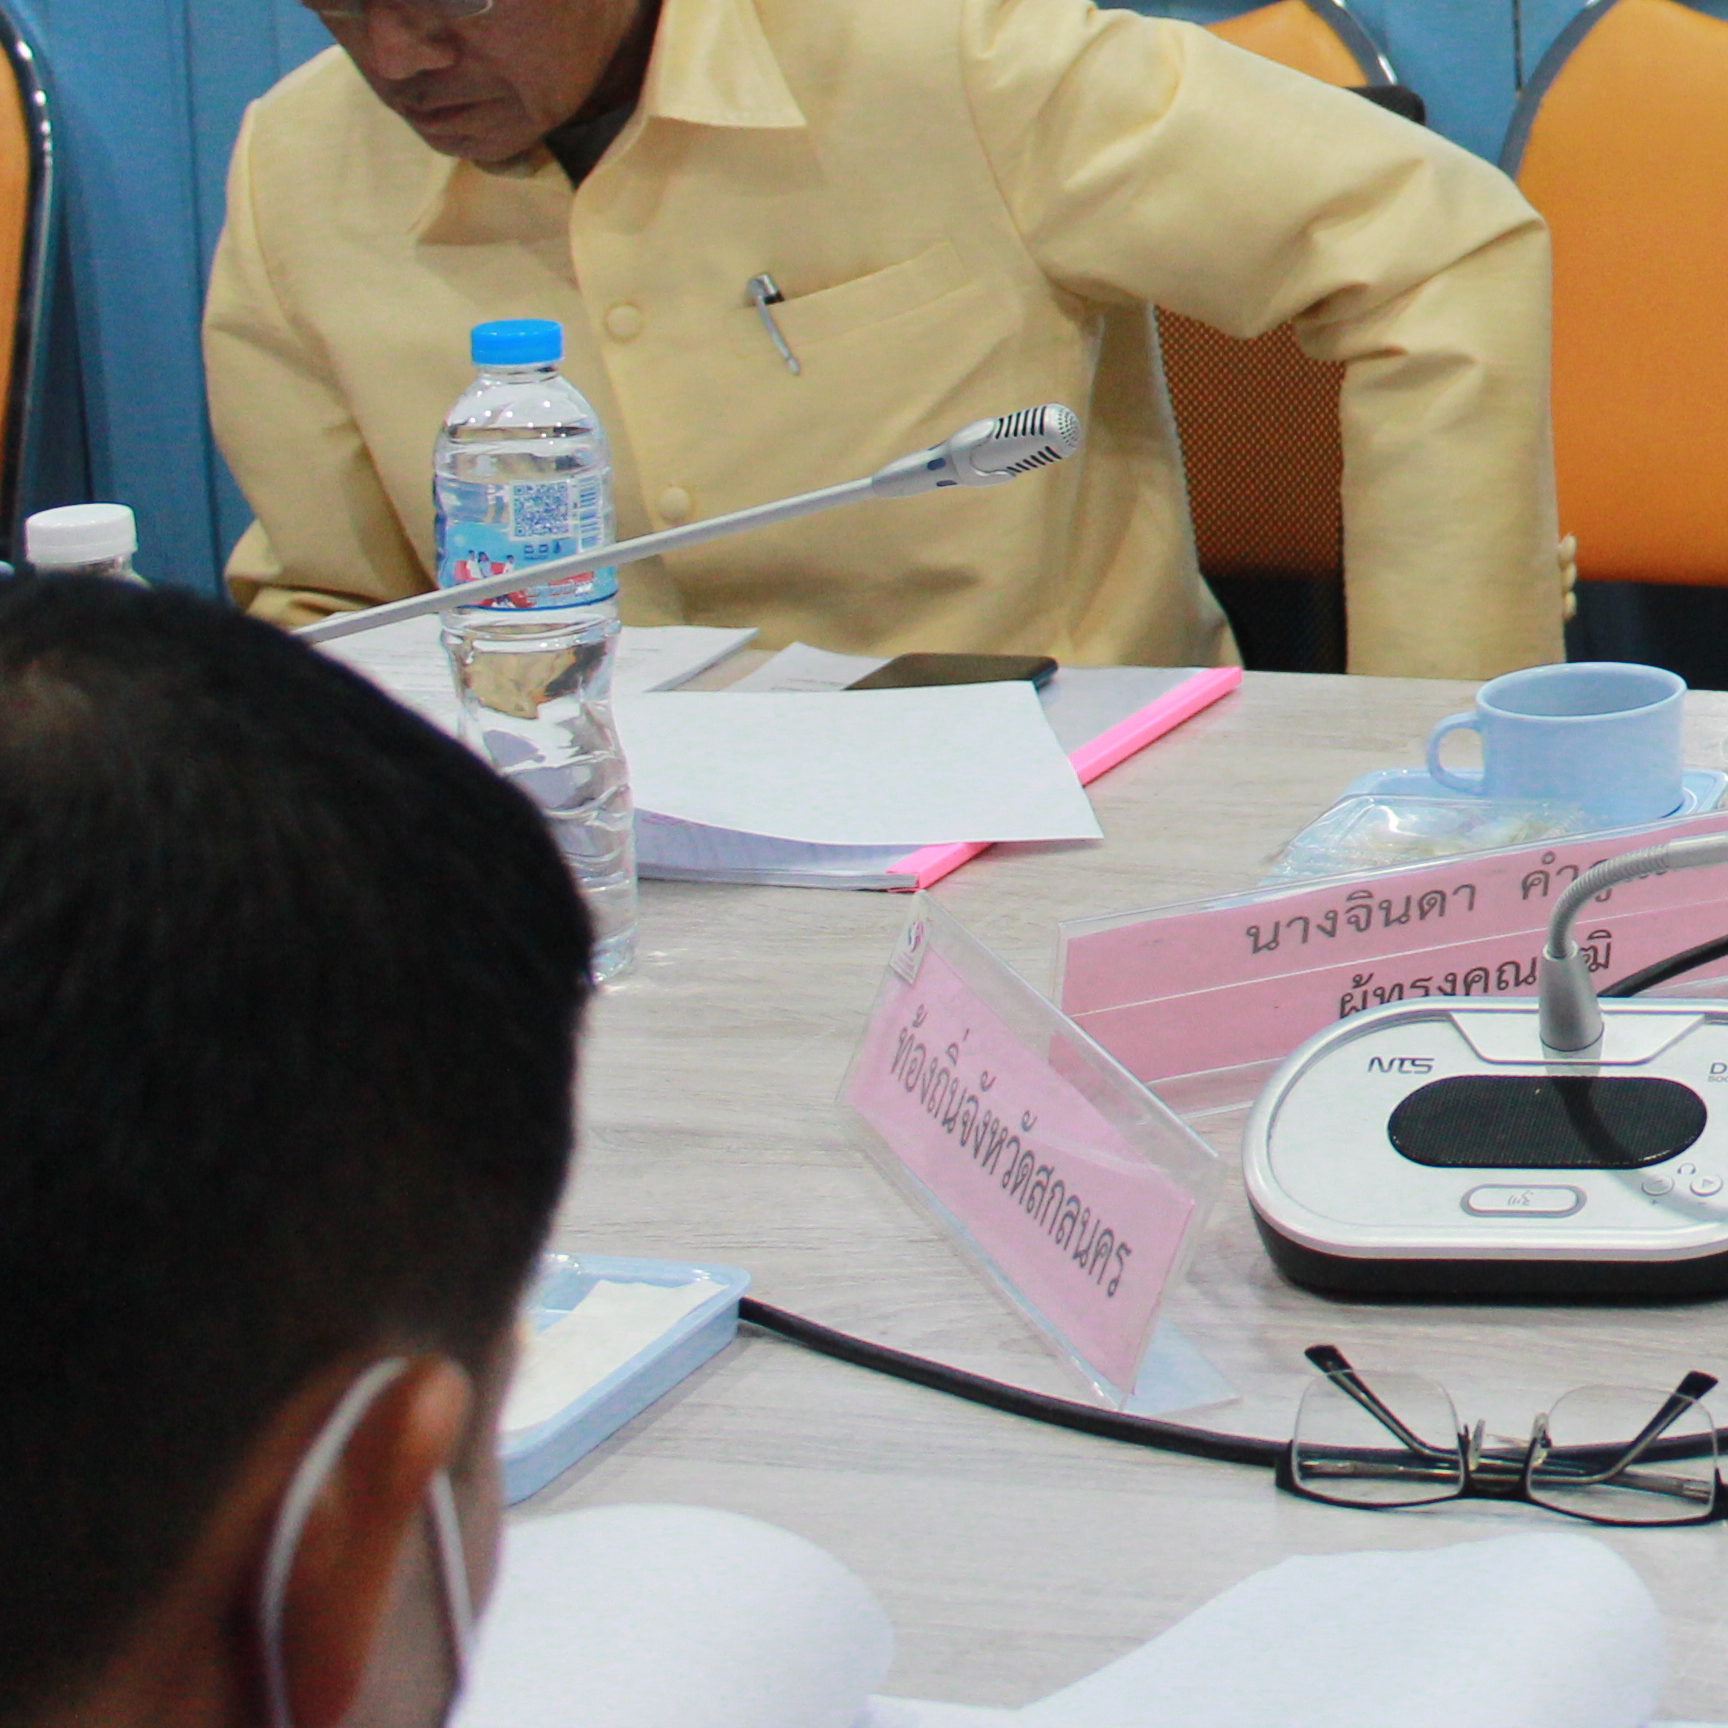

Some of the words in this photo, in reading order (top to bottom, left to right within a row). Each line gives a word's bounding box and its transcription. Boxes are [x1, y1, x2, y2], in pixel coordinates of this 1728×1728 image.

[1245, 883, 1477, 955] นางจินดา
[1367, 1056, 1436, 1074] NTS
[889, 1002, 1133, 1298] ท้องถิ่นจังหวัดสกลนคร
